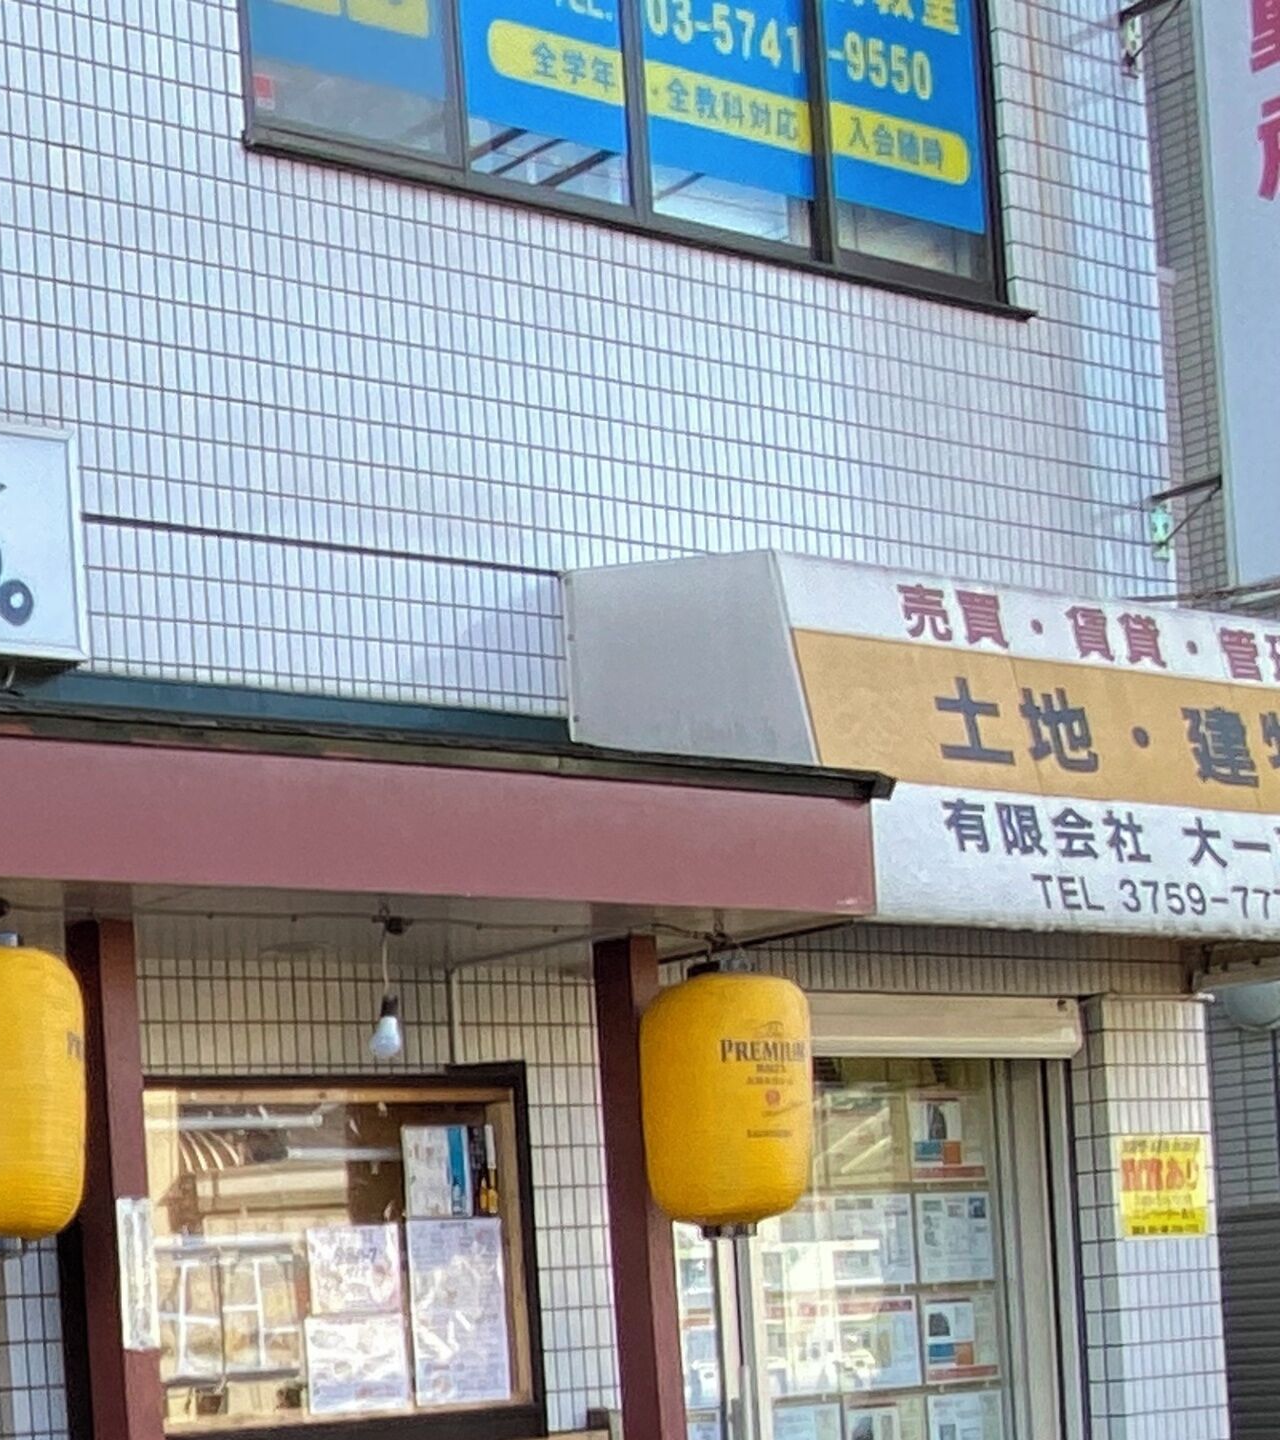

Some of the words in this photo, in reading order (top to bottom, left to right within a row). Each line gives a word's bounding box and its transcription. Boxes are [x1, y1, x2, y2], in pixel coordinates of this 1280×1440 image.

[531, 41, 617, 92] 全学年
[940, 797, 1153, 866] 有限会社
[1181, 815, 1280, 870] 大一
[1029, 872, 1106, 912] TEL
